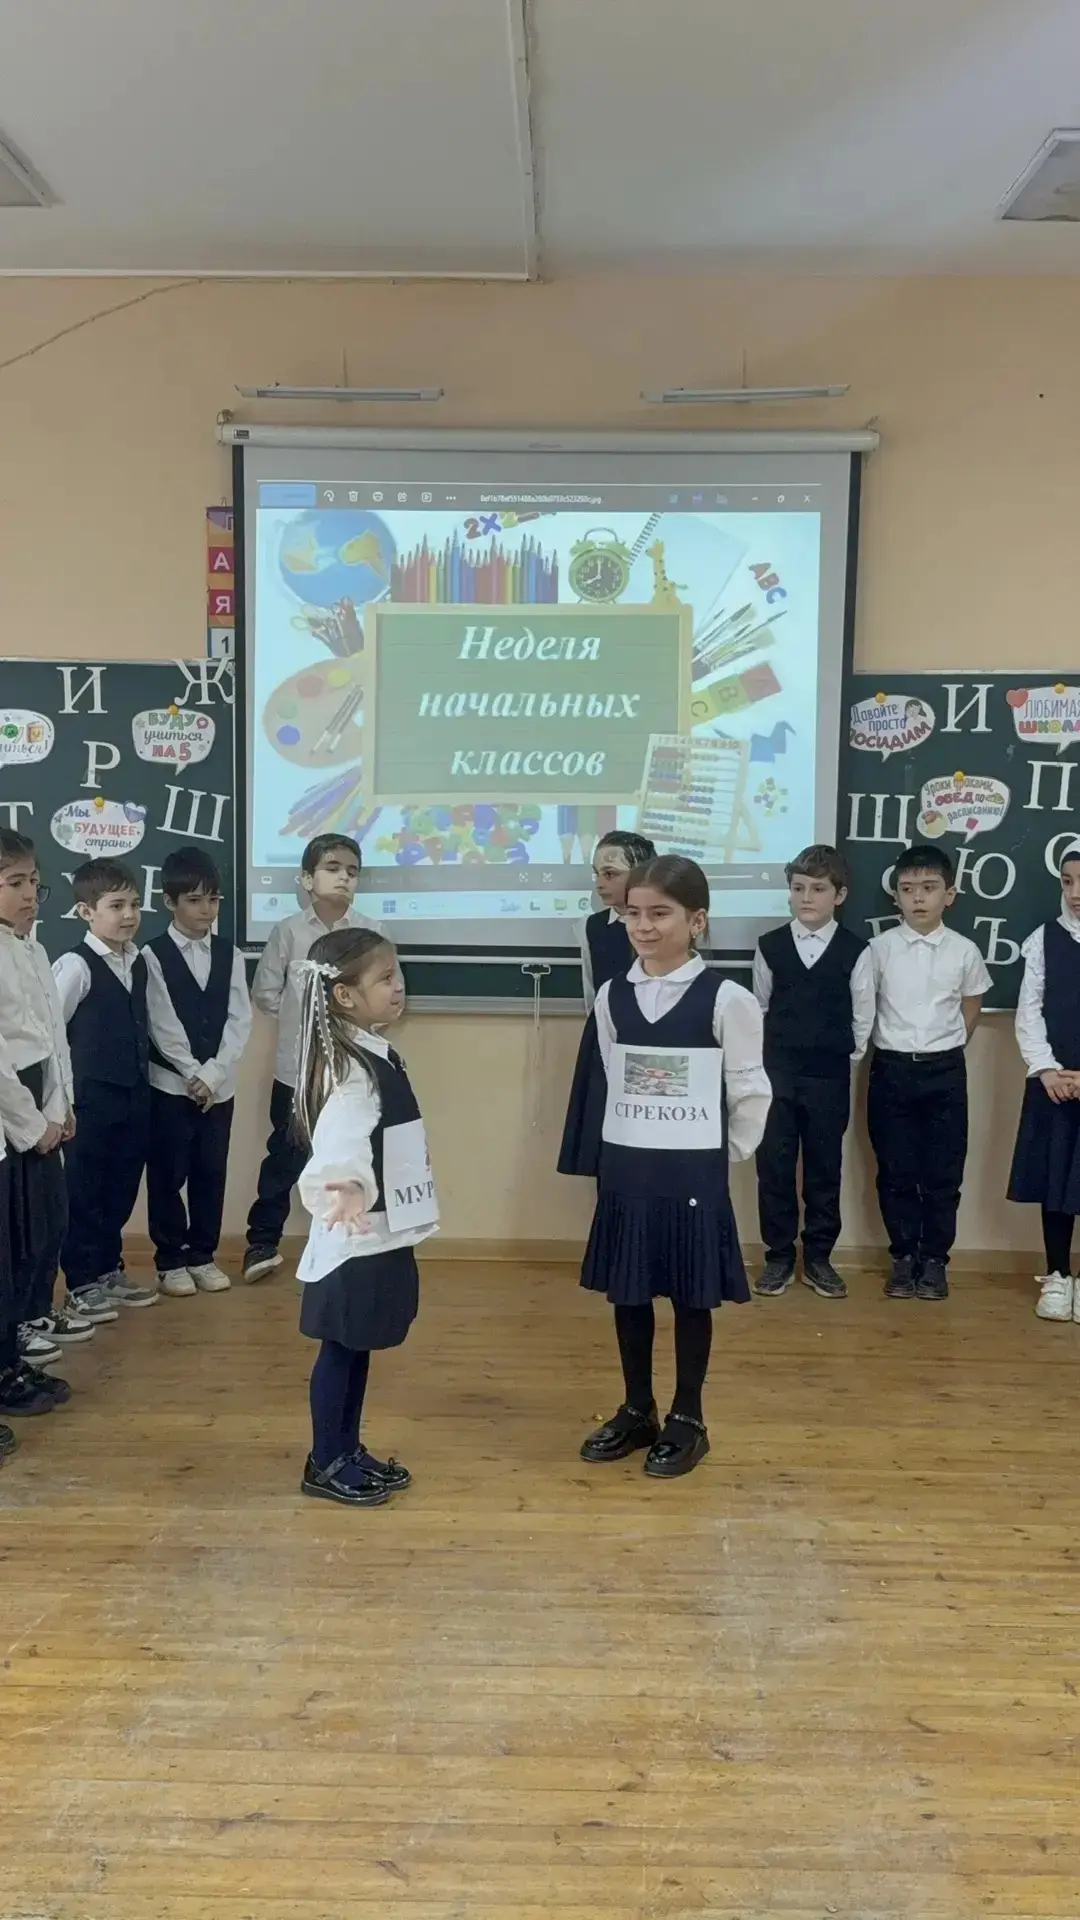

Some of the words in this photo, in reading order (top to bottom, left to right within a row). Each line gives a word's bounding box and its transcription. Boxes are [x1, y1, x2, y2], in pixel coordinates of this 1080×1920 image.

[213, 552, 231, 571] А
[215, 595, 231, 614] Я
[220, 635, 230, 655] 1
[456, 625, 601, 661] Неделя
[57, 666, 108, 714] И
[172, 657, 235, 706] Ж
[417, 691, 641, 718] начальных
[852, 703, 899, 725] Давайте
[940, 683, 994, 733] И
[148, 712, 196, 730] БУДУ
[868, 718, 908, 737] просто
[144, 730, 204, 745] учиться
[152, 744, 176, 758] НА
[178, 741, 192, 761] 5
[80, 740, 121, 788] Р
[450, 749, 606, 776] классов
[1022, 760, 1078, 811] П
[935, 791, 975, 806] ОБЕД
[64, 805, 91, 818] Мы
[156, 784, 231, 842] Ш
[845, 792, 916, 850] Щ
[74, 822, 137, 837] БУДУЩЕЕ
[84, 837, 134, 851] страны
[952, 847, 1016, 900] Ю
[973, 916, 1021, 965] Ъ
[614, 1101, 709, 1121] СТРЕКОЗА
